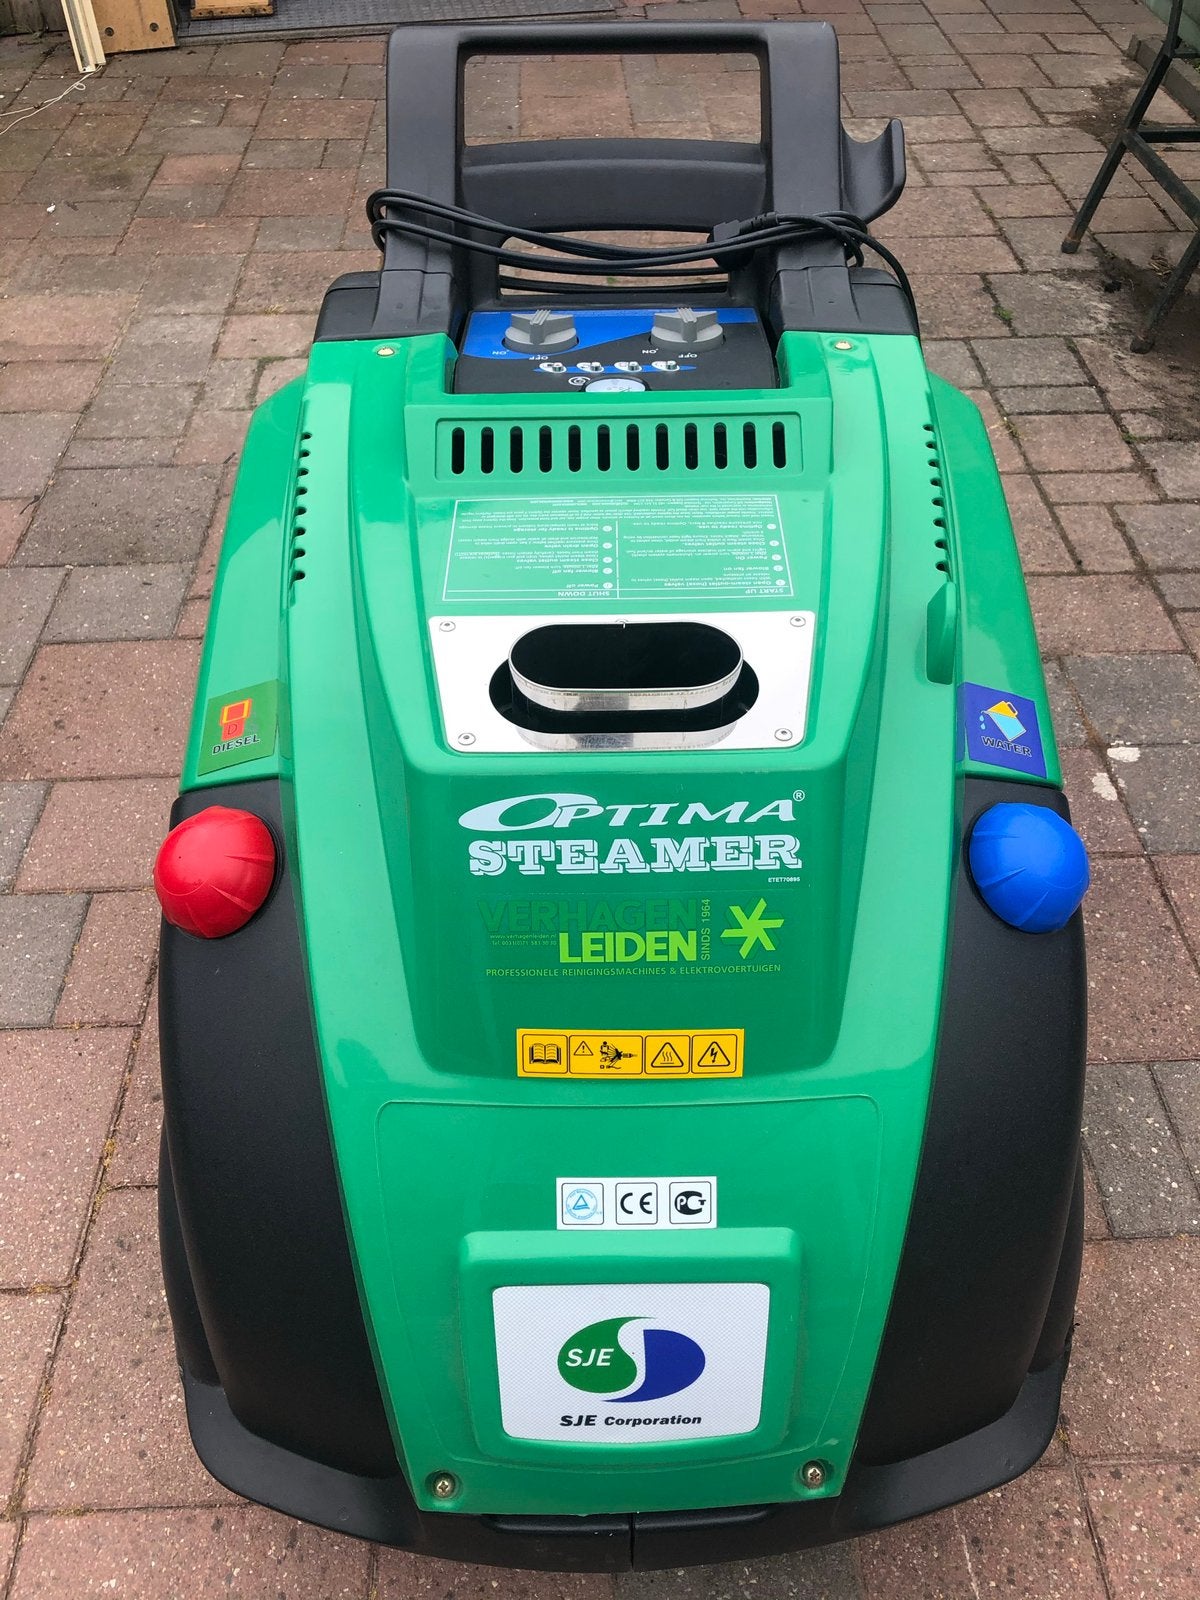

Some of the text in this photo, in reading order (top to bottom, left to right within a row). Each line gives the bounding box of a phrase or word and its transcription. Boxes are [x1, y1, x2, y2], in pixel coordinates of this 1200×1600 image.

[212, 734, 260, 755] DIESEL
[981, 735, 1033, 757] WATER
[458, 792, 797, 832] OPTIMA
[468, 834, 803, 875] STEAMER
[477, 898, 698, 932] VERHAGEN
[701, 898, 711, 960] SINDS 1964
[559, 930, 697, 963] LEIDEN
[485, 964, 781, 977] PROFESSIONELE REINIGINGSMACHINES & ELEKTROVOERTUIGEN
[565, 1348, 614, 1367] SJE
[560, 1414, 702, 1428] SJE Corporation
